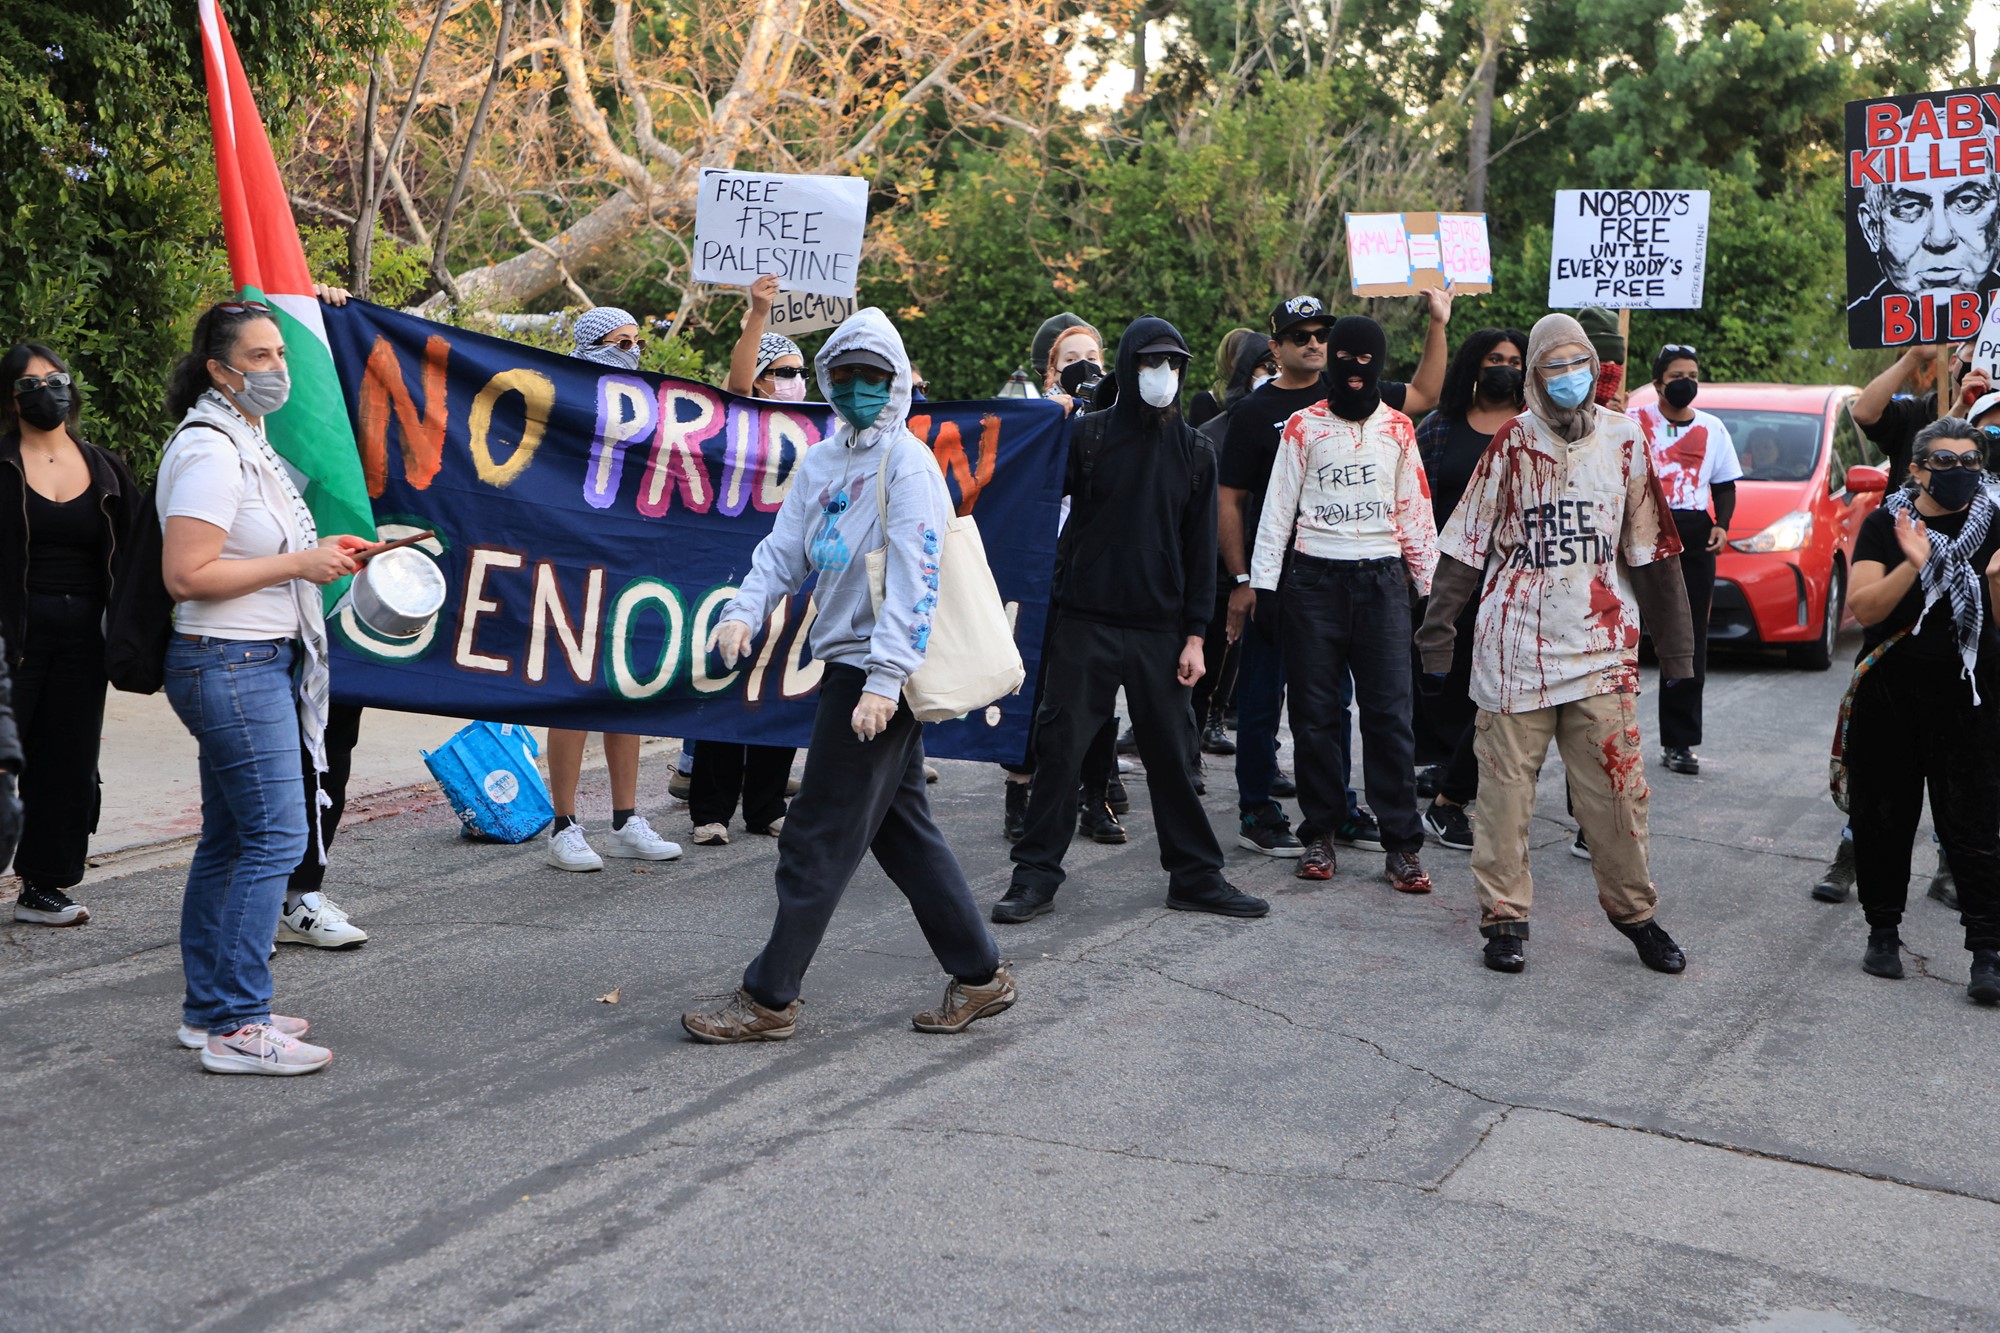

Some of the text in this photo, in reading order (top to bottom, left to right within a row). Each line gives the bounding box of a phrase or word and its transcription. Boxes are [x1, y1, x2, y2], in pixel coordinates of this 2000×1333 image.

[1850, 135, 2000, 188] KILLE
[716, 179, 784, 203] FREE
[1579, 190, 1690, 217] NOBODY'S
[735, 206, 824, 244] FREE
[1440, 219, 1483, 243] SPIRO
[1601, 217, 1671, 243] FREE
[1349, 227, 1409, 256] KAMALA
[1590, 242, 1665, 259] UNTIL
[702, 240, 853, 283] PALESTINE
[1595, 279, 1665, 298] FREE
[1881, 288, 1999, 345] BIB
[358, 333, 557, 499] NO
[583, 372, 843, 518] PRID
[1316, 463, 1377, 493] FREE
[1523, 500, 1597, 540] FREE
